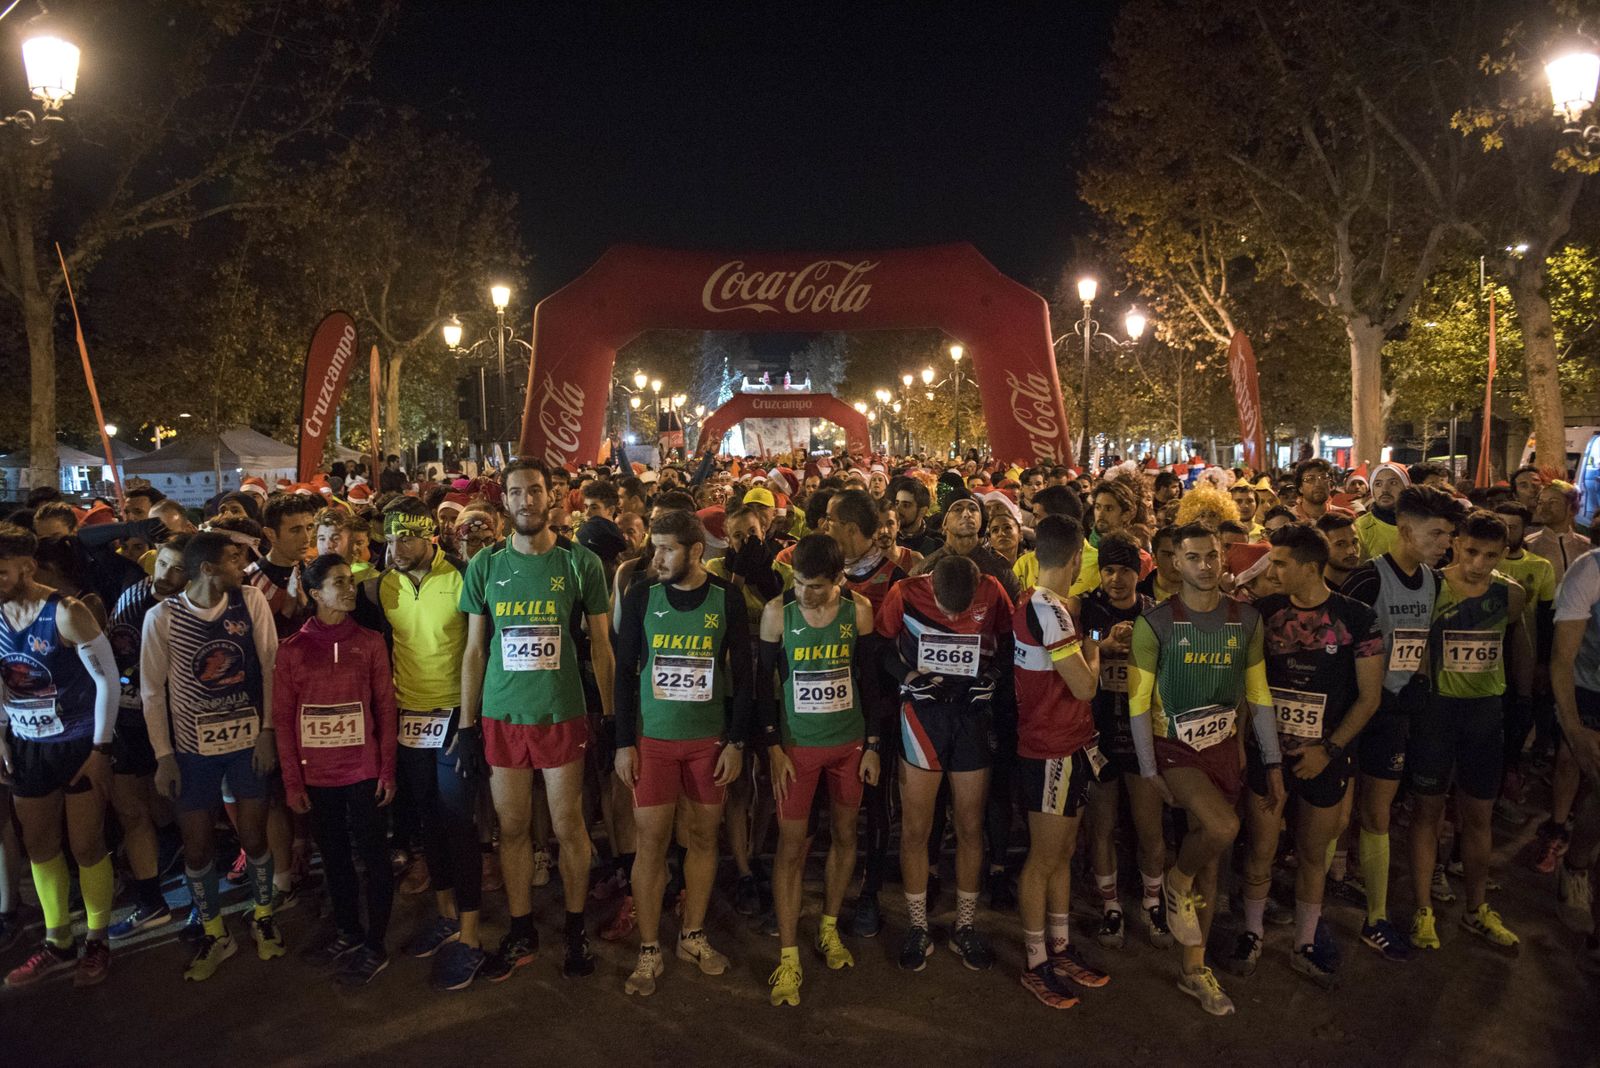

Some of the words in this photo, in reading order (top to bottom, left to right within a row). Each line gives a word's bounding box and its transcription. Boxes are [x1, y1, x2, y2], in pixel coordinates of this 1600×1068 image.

[702, 260, 882, 314] Coca-Cola
[305, 322, 357, 438] Cruzcampo
[752, 398, 813, 411] Cruzcampo
[495, 600, 557, 617] BIKILA
[1388, 601, 1428, 618] nerja
[506, 643, 556, 658] 2450
[652, 633, 714, 651] BIKILA
[793, 643, 850, 661] BIKILA
[923, 648, 974, 664] 2668
[1184, 652, 1232, 665] BIKILA
[1449, 646, 1499, 661] 1765
[656, 672, 708, 689] 2254
[798, 684, 848, 701] 2098
[202, 722, 253, 744] 2471
[307, 719, 357, 736] 1541
[403, 722, 444, 737] 1540
[1184, 717, 1229, 742] 1426
